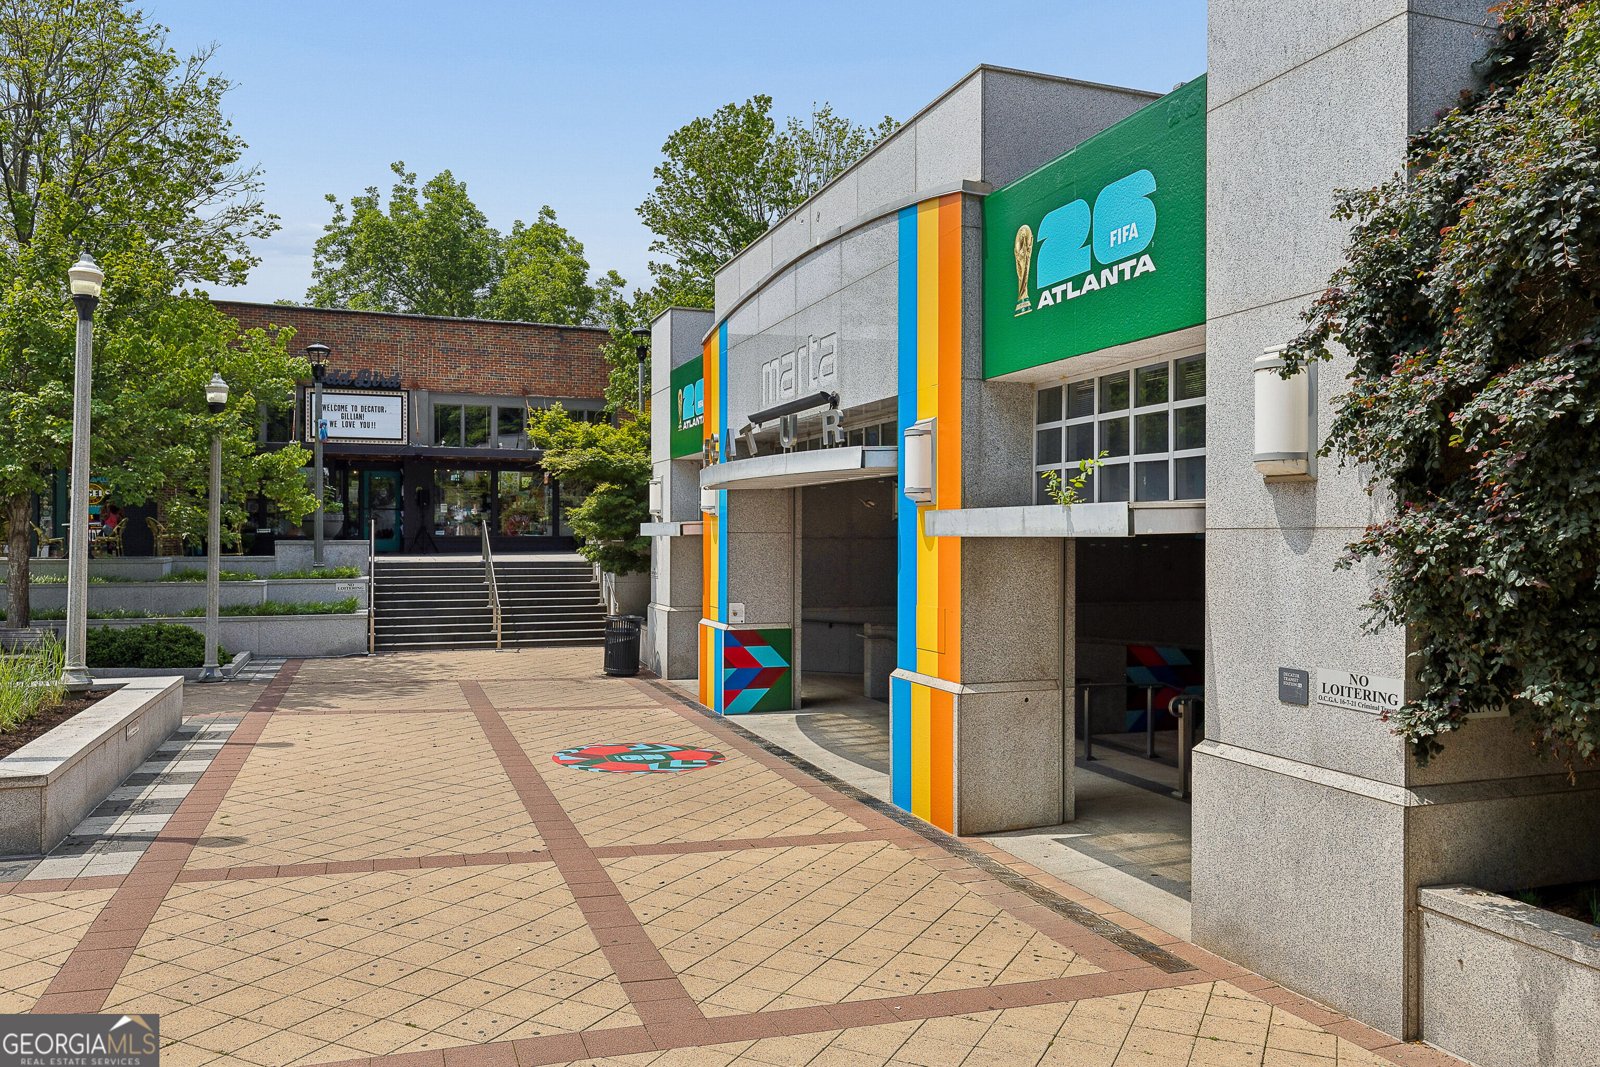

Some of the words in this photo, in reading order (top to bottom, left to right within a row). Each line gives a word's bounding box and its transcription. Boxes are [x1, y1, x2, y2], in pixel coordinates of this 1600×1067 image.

[1036, 169, 1157, 290] 26
[1109, 222, 1139, 248] FIFA
[1036, 253, 1157, 310] ATLANTA
[762, 332, 838, 405] marta
[322, 404, 348, 412] WELCOME
[360, 405, 387, 413] DECATUR,
[329, 420, 338, 428] WE
[341, 421, 356, 429] LOVE
[359, 421, 376, 429] YOU!!
[340, 413, 365, 421] GILLIAN!
[682, 415, 704, 430] ATLANT
[1349, 673, 1369, 687] NO
[1322, 682, 1398, 706] LOITERING
[1357, 702, 1380, 711] Criminal
